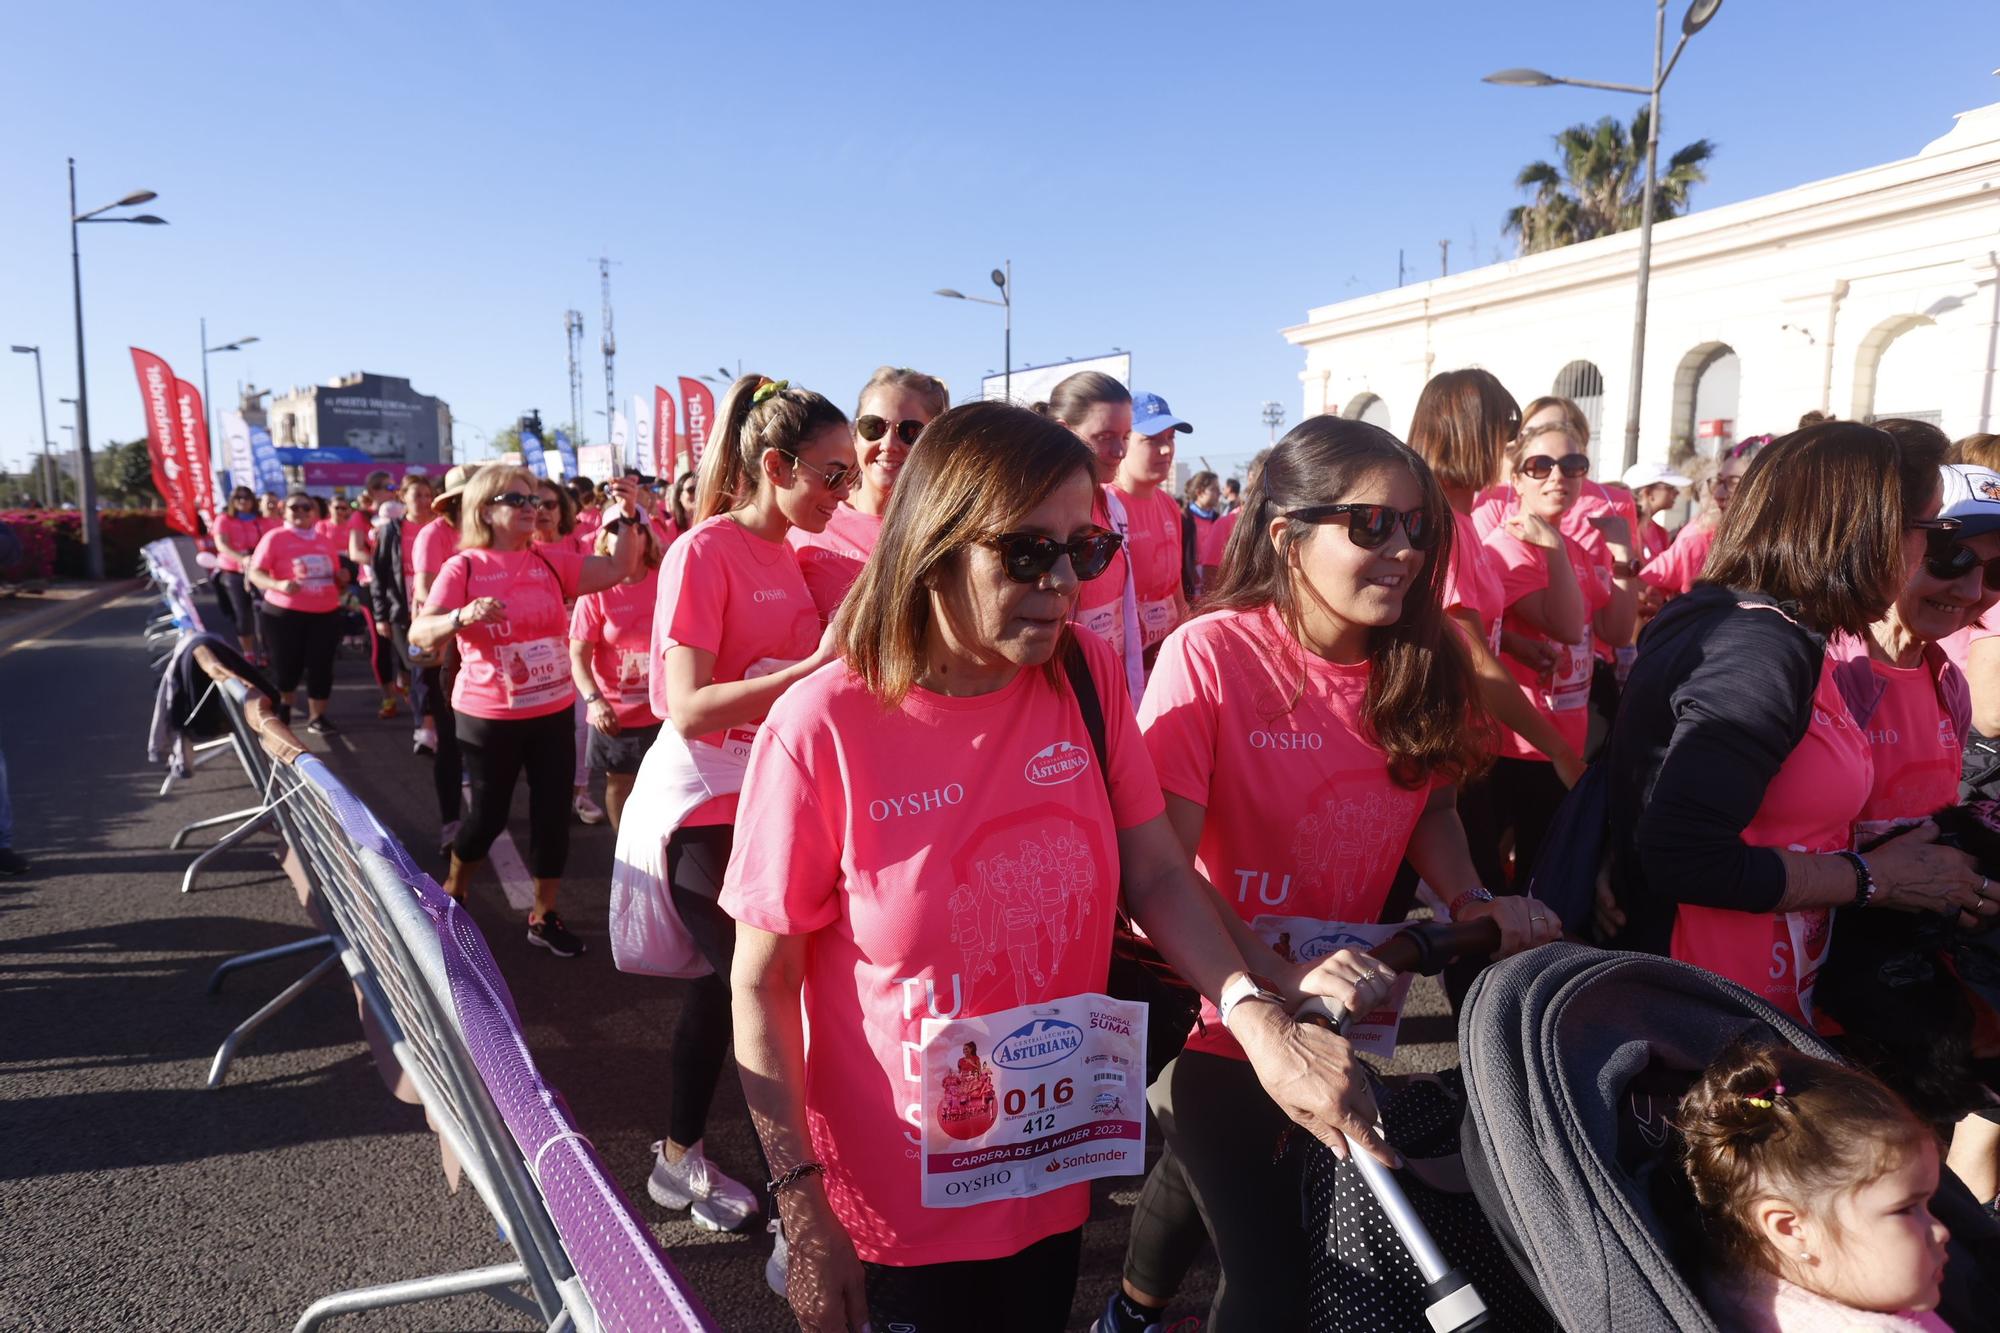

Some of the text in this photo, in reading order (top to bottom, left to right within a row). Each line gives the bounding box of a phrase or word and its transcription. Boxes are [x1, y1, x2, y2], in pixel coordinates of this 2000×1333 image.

[485, 620, 512, 639] TU
[531, 663, 554, 677] 016
[1250, 730, 1323, 751] OYSHO
[733, 746, 749, 757] OY
[868, 783, 965, 822] OYSHO
[1234, 868, 1292, 906] TU
[892, 973, 963, 1020] TU
[1089, 1018, 1131, 1036] SUMA
[1100, 1013, 1131, 1027] DORSAL
[999, 1035, 1078, 1063] ASTURIANA
[1014, 1035, 1042, 1047] CENTRAL
[1003, 1077, 1074, 1116] 016
[1022, 1114, 1056, 1135] 412
[952, 1124, 1123, 1168] CARRERA DE LA MUJER 2023
[1062, 1149, 1128, 1170] Santander
[945, 1169, 1012, 1196] OYSHO
